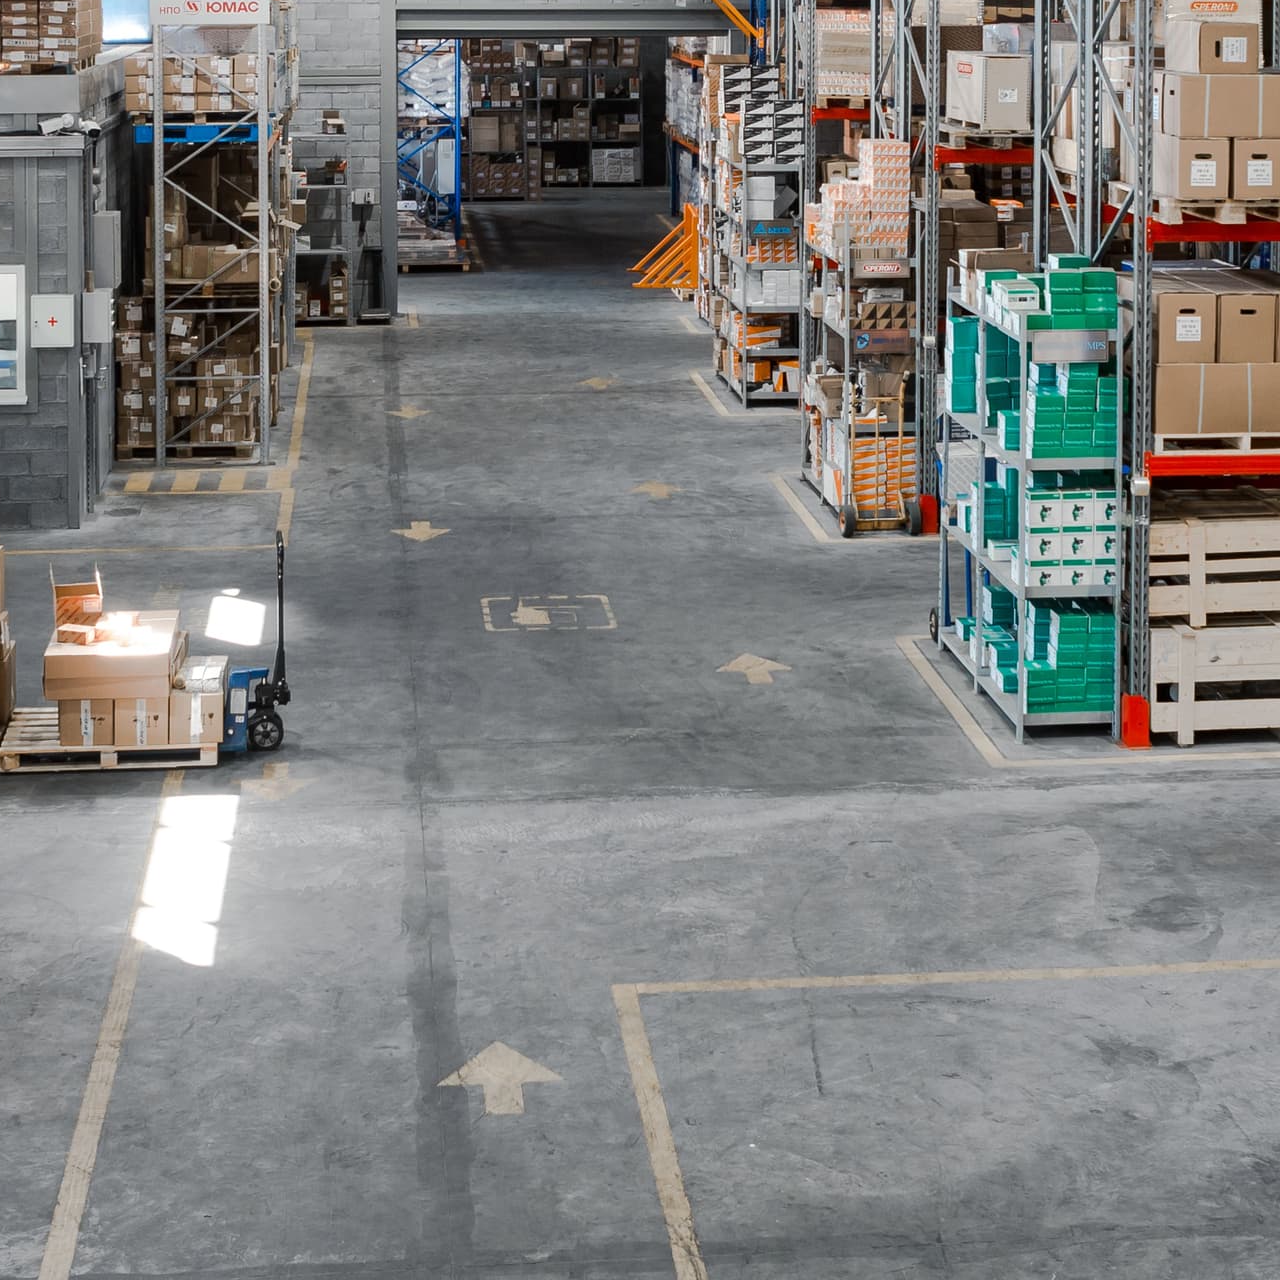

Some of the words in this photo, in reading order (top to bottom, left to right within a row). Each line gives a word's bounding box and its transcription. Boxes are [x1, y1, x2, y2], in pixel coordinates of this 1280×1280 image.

[160, 6, 181, 15] НПО
[206, 1, 259, 13] ЮМАС
[1192, 2, 1236, 11] SPERONI
